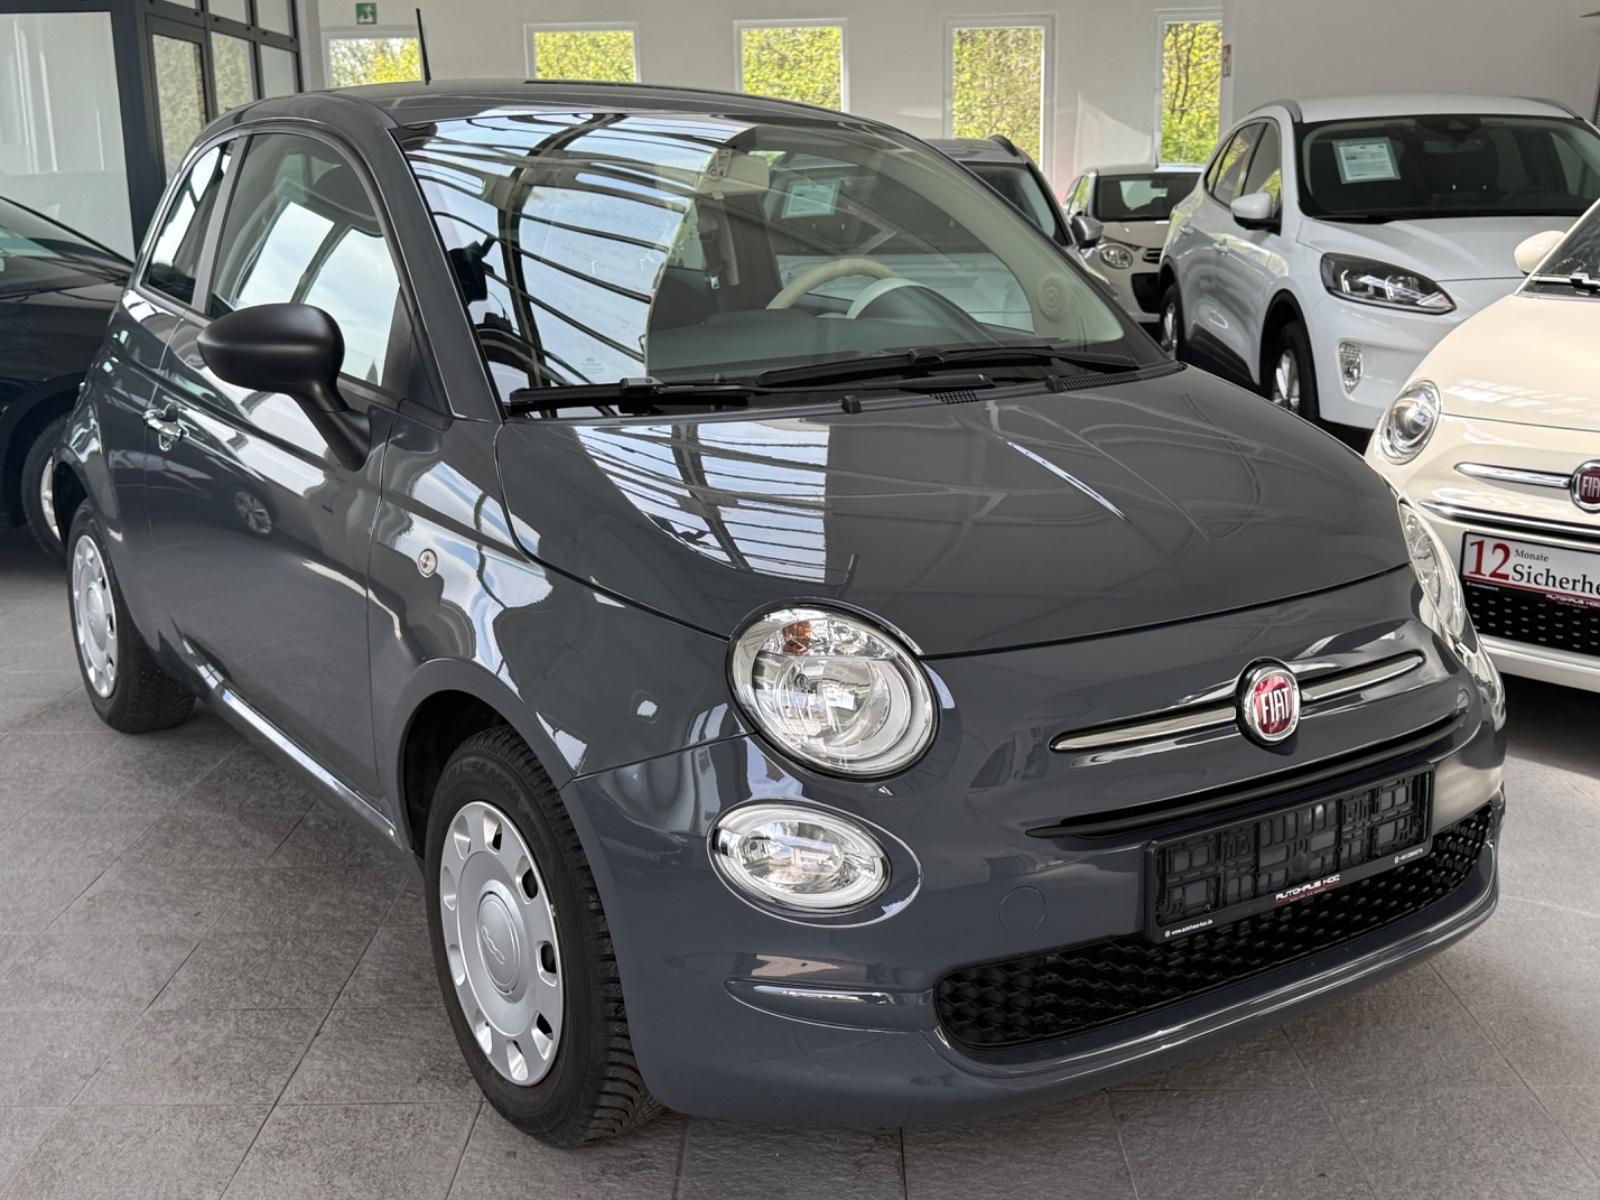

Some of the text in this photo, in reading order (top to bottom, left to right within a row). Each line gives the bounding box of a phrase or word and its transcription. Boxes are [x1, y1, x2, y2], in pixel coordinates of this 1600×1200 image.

[1469, 539, 1549, 580] 12 Monate
[1261, 688, 1290, 725] FIAT
